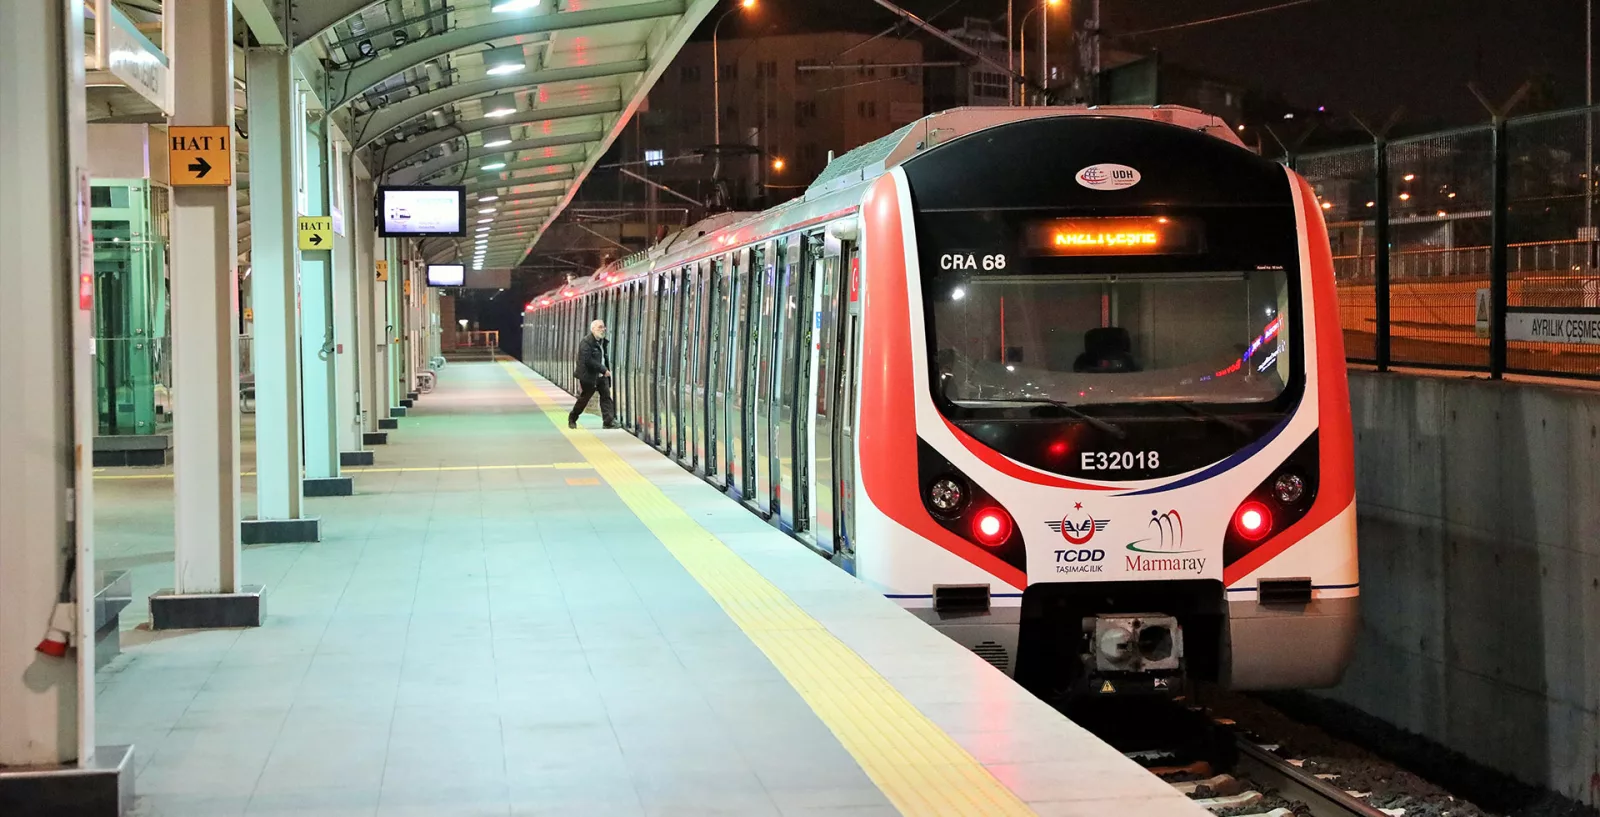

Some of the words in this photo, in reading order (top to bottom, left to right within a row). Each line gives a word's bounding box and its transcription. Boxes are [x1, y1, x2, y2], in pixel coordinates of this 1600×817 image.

[171, 136, 213, 151] HAT
[219, 136, 226, 151] 1
[1112, 170, 1133, 179] UDH
[300, 222, 324, 231] HAT
[326, 222, 331, 231] 1
[940, 254, 978, 270] CRA
[982, 253, 1006, 271] 68
[1531, 318, 1564, 337] AYRILIK
[1081, 451, 1160, 470] E32018
[1054, 549, 1106, 563] TCDD
[1125, 555, 1207, 575] Marmaray
